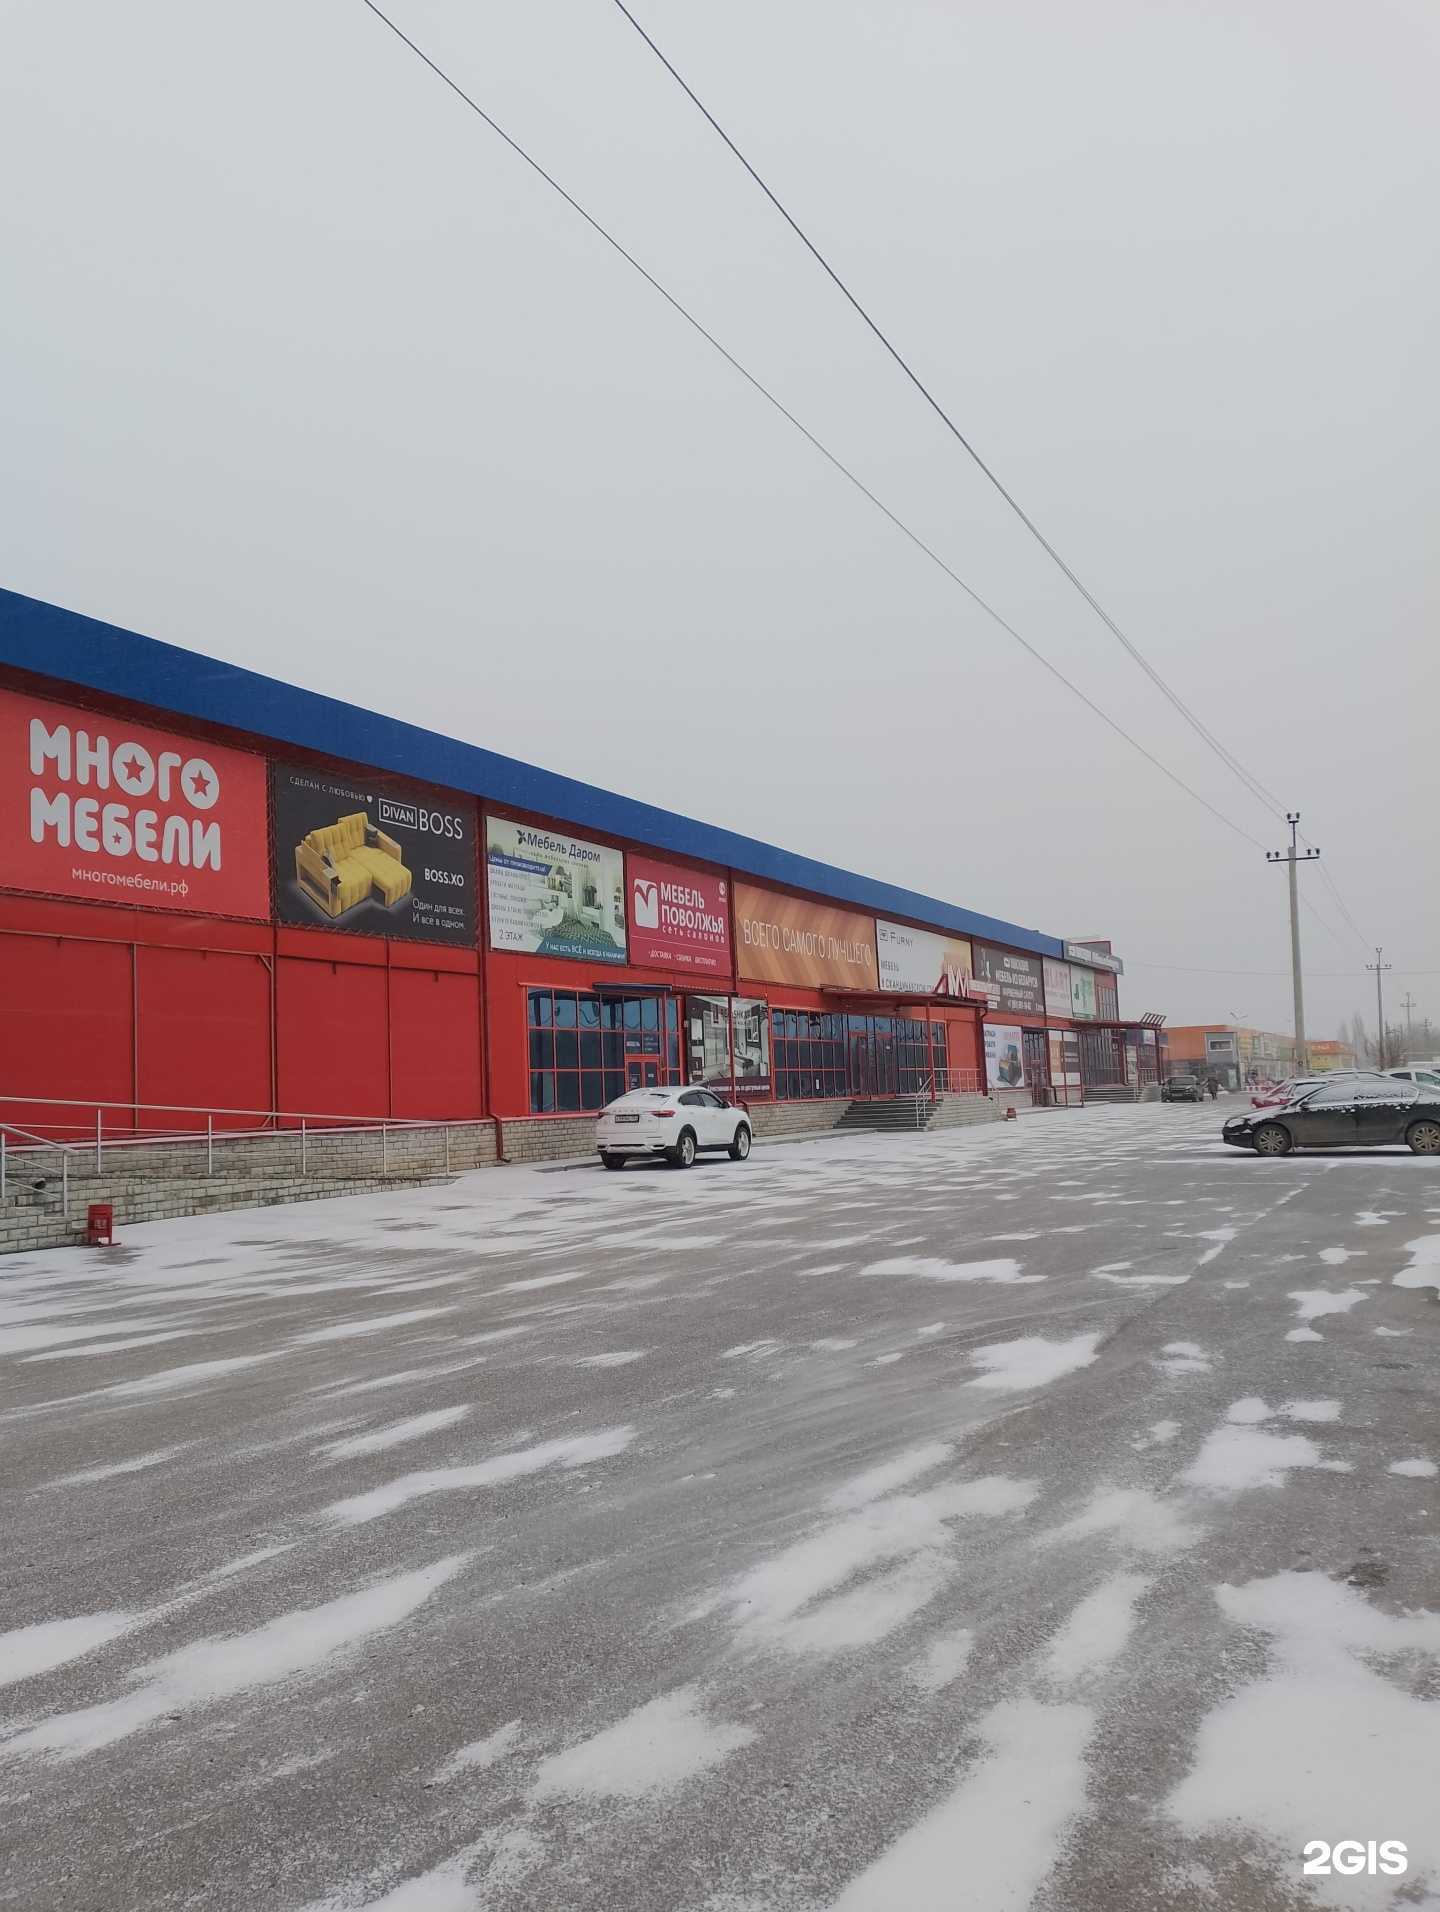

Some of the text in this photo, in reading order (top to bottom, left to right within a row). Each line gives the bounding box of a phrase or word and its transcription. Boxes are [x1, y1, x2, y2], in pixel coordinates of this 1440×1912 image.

[29, 718, 220, 810] МНОГО
[289, 776, 320, 791] СДЕЛАН
[328, 787, 366, 801] ЛЮБОВЬЮ
[30, 787, 222, 871] МЕБЕЛИ
[382, 804, 463, 839] DIVAN BOSS
[527, 832, 567, 855] Мебель
[569, 843, 601, 863] Даром
[72, 868, 189, 897] многомебели.рф
[660, 881, 704, 909] МЕБЕЛЬ
[412, 912, 420, 923] И
[413, 898, 433, 911] Один
[434, 904, 447, 913] для
[661, 904, 725, 934] ПОВОЛЖЬЯ
[743, 919, 871, 967] ВСЕГО САМОГО ЛУЧШЕГО
